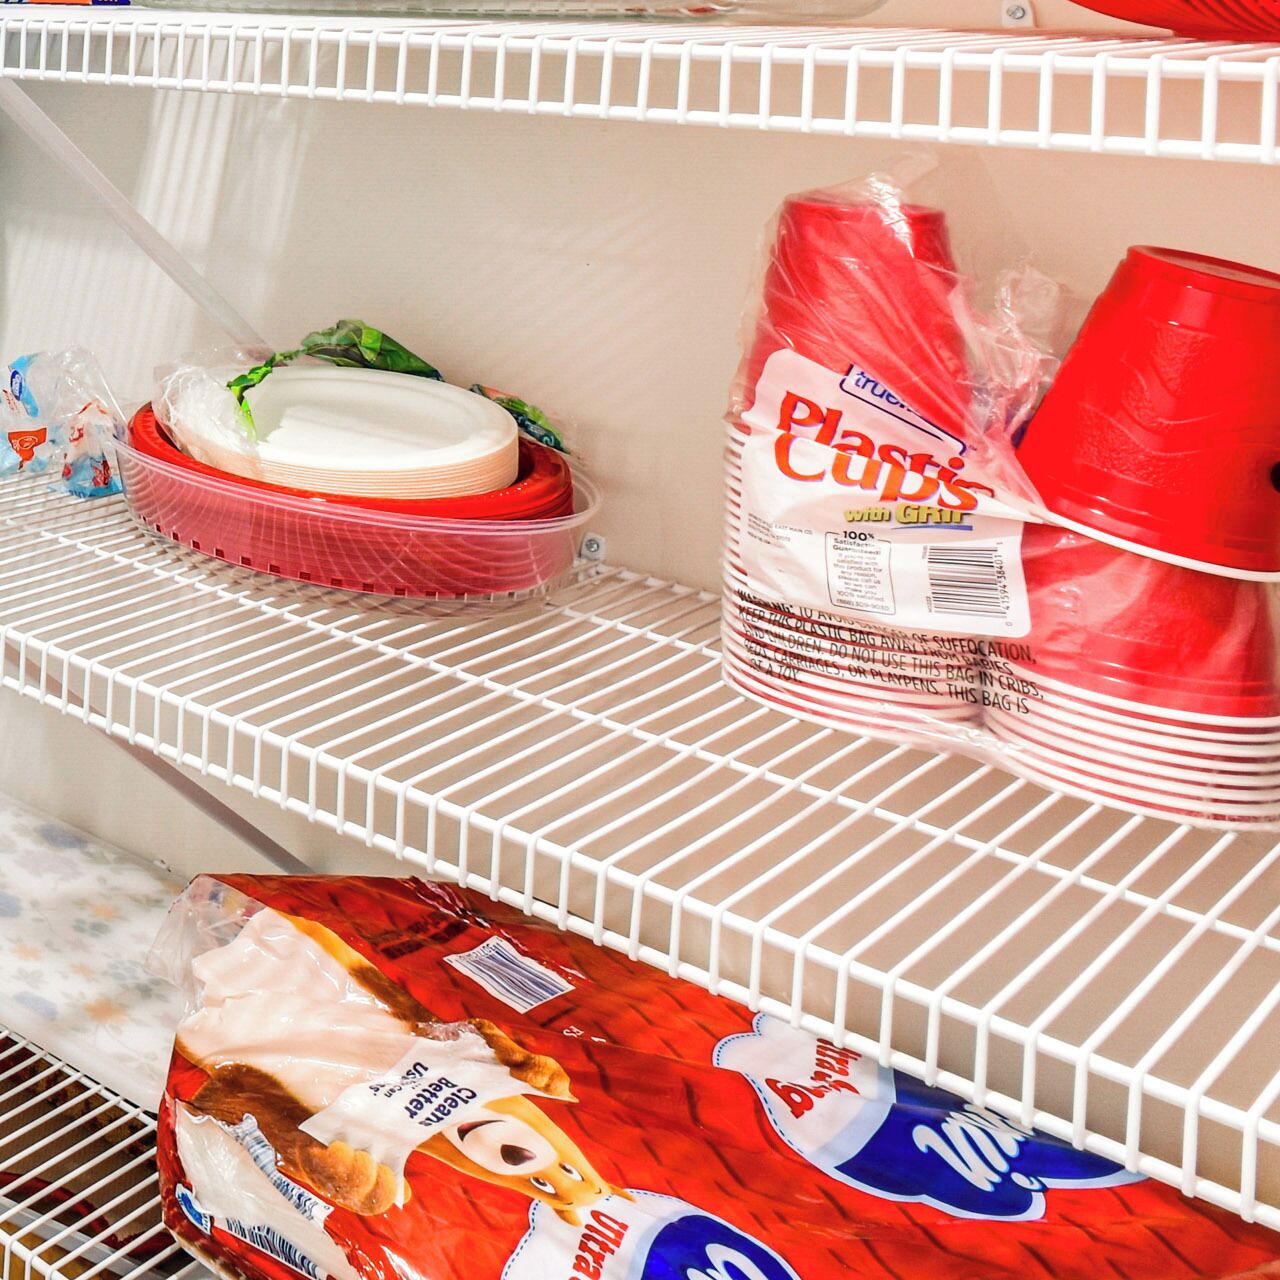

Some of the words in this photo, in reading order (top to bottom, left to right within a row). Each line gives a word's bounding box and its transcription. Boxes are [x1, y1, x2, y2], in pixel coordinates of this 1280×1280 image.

[774, 432, 979, 511] Cups
[842, 530, 875, 541] 100%
[843, 506, 892, 523] with
[738, 605, 766, 623] KEEP
[767, 610, 794, 629] THIS
[795, 618, 847, 642] PLASTIC
[849, 629, 876, 647] BAG
[880, 636, 918, 655] AWAY
[921, 644, 961, 663] FROM
[960, 655, 1015, 676] BABIES
[799, 606, 813, 619] TO
[911, 632, 927, 645] OF
[932, 635, 1037, 664] SUFFOCATION,
[765, 662, 774, 675] A
[773, 648, 846, 677] CARRIAGES,
[848, 663, 868, 678] OR
[870, 668, 944, 696] PLAYPENS.
[946, 682, 978, 703] THIS
[981, 689, 1011, 710] BAG
[1015, 697, 1030, 714] IS
[828, 642, 848, 659] DO
[851, 648, 878, 665] NOT
[879, 654, 906, 671] USE
[911, 656, 941, 678] THIS
[945, 664, 974, 684] BAG
[978, 670, 994, 687] IN
[998, 673, 1045, 700] CRIBS,
[404, 1076, 459, 1119] Better
[418, 1087, 478, 1127] Cleans
